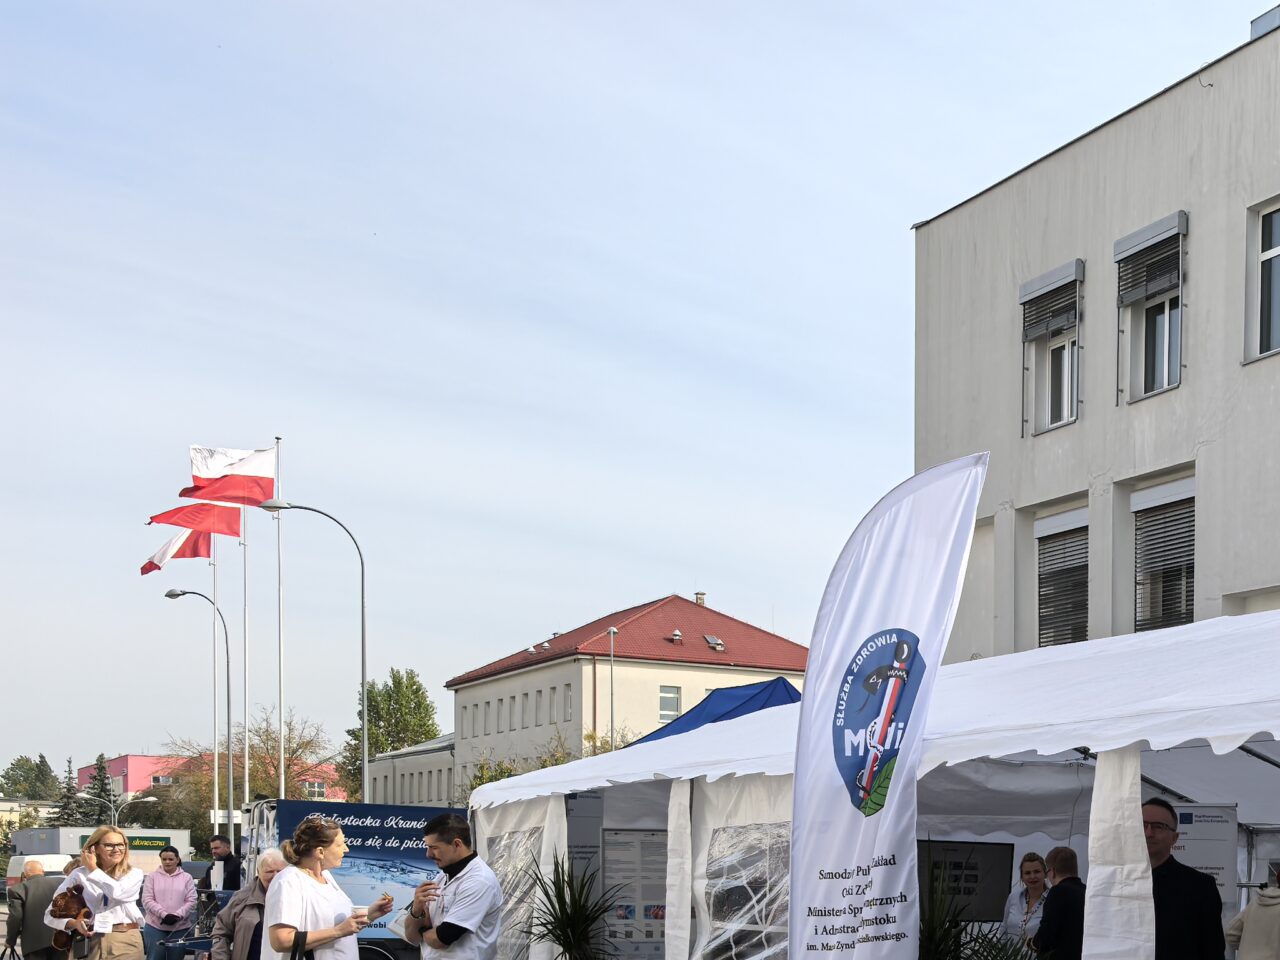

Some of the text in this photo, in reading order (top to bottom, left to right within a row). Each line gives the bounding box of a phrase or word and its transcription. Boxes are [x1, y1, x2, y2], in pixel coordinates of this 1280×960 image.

[836, 633, 898, 727] SŁUŻBA ZDROWIA
[365, 836, 383, 849] się
[385, 836, 400, 847] do
[807, 942, 819, 951] im.
